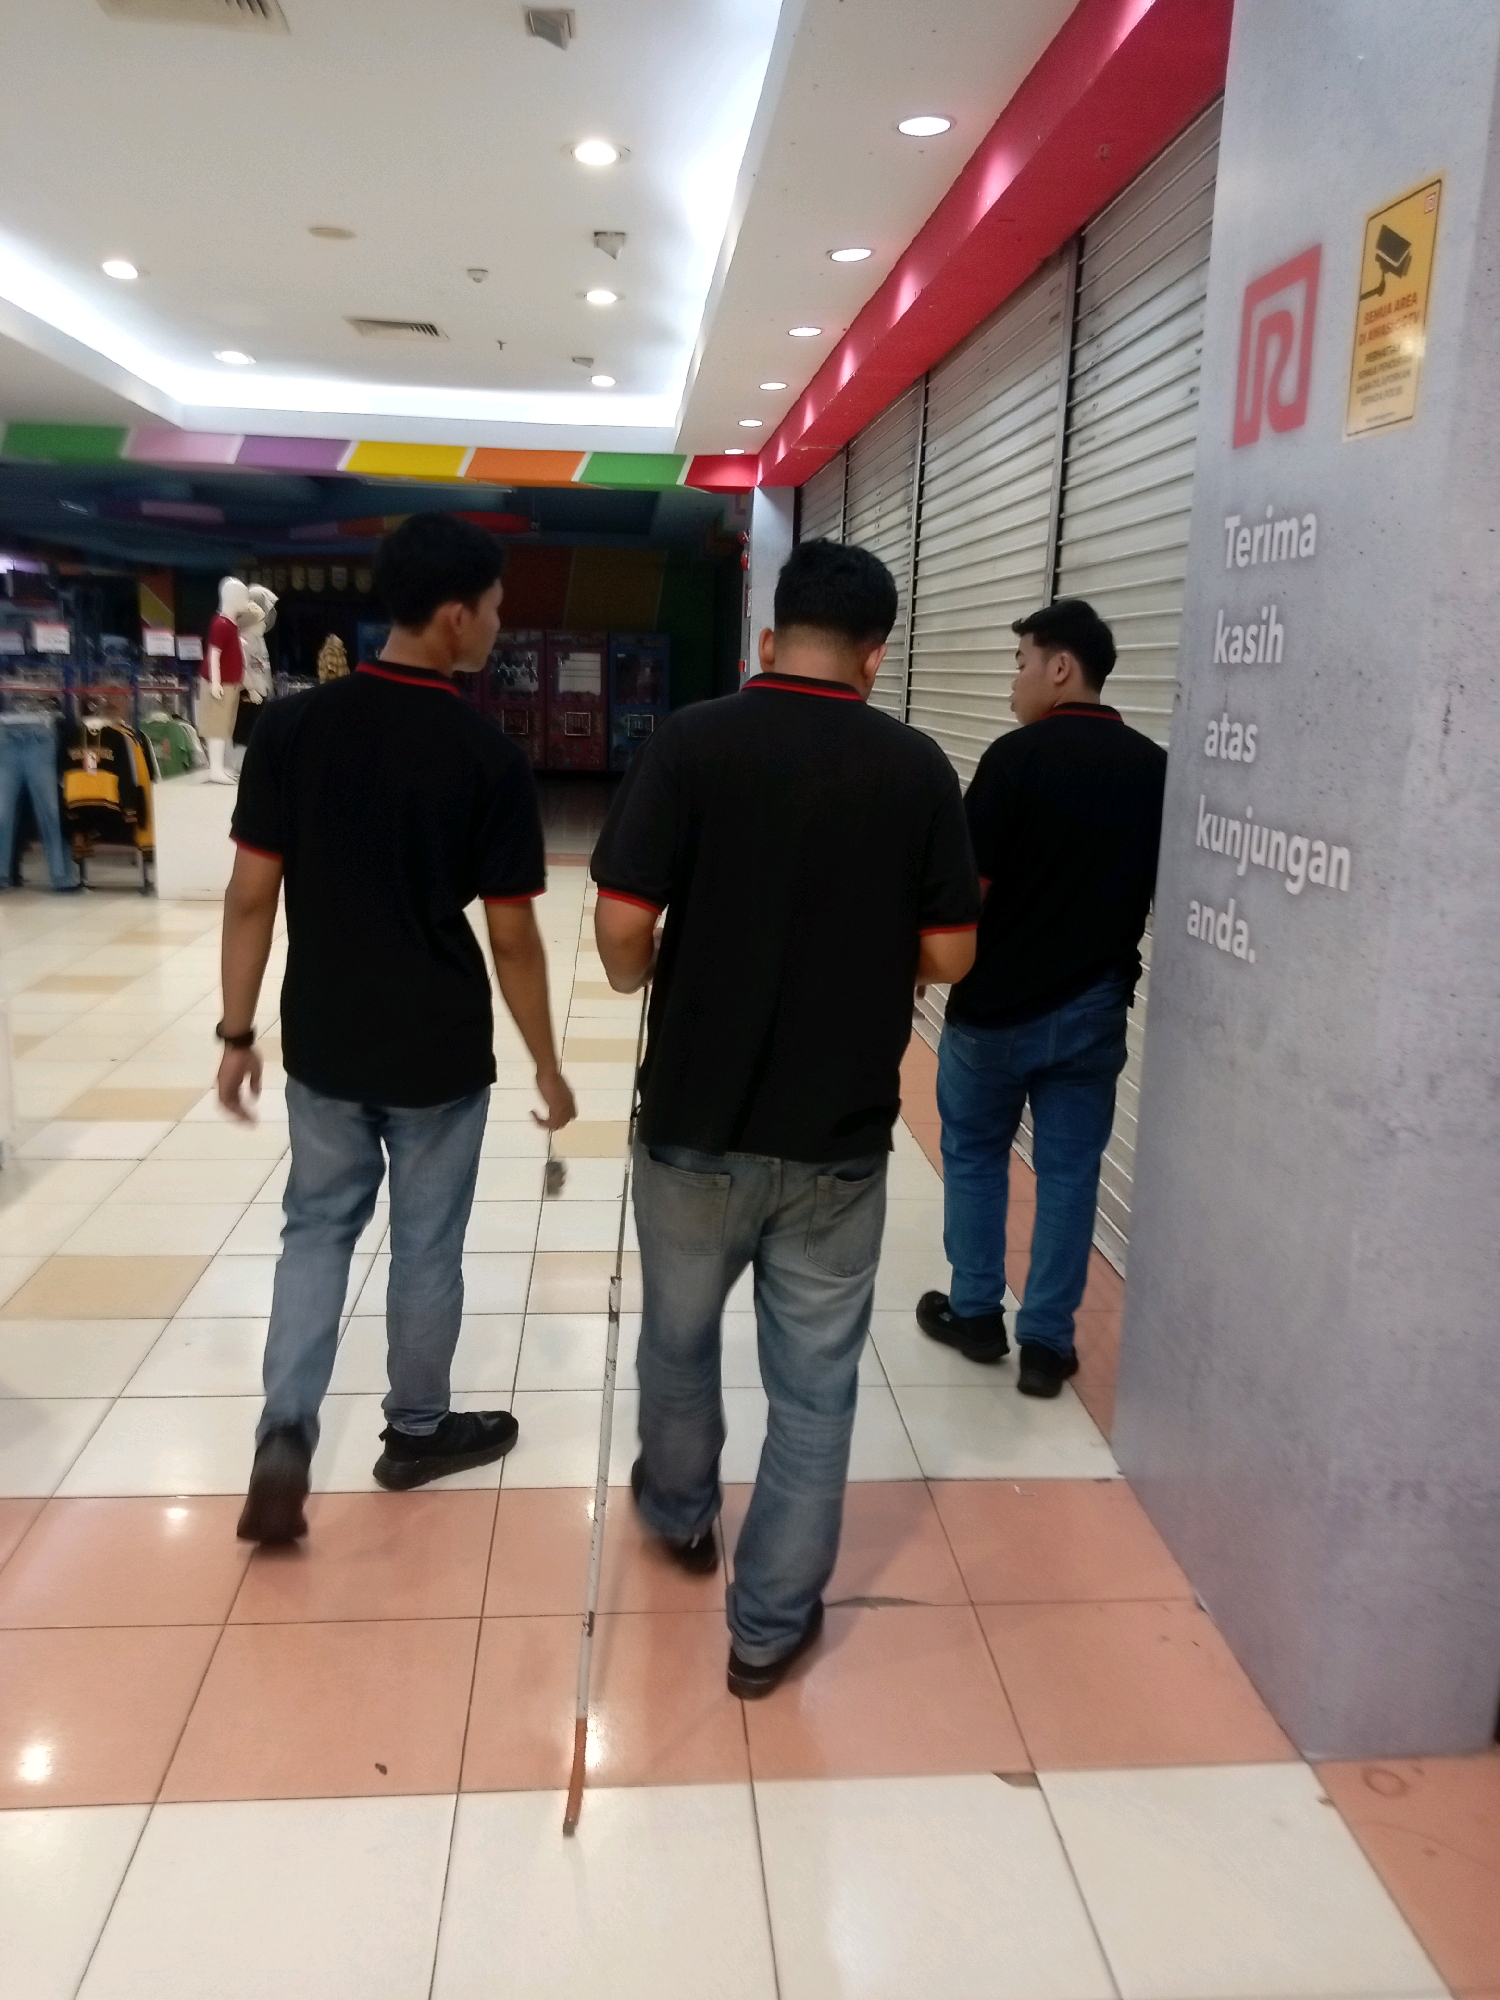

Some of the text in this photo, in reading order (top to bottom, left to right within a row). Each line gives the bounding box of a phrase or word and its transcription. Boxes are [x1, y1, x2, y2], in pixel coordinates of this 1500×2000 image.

[1364, 292, 1417, 325] SEMUA AREA
[1225, 505, 1317, 568] Terima
[1213, 605, 1284, 664] kasih
[1203, 713, 1258, 763] atas
[1195, 795, 1351, 895] kunjungan
[1186, 898, 1256, 964] anda.
